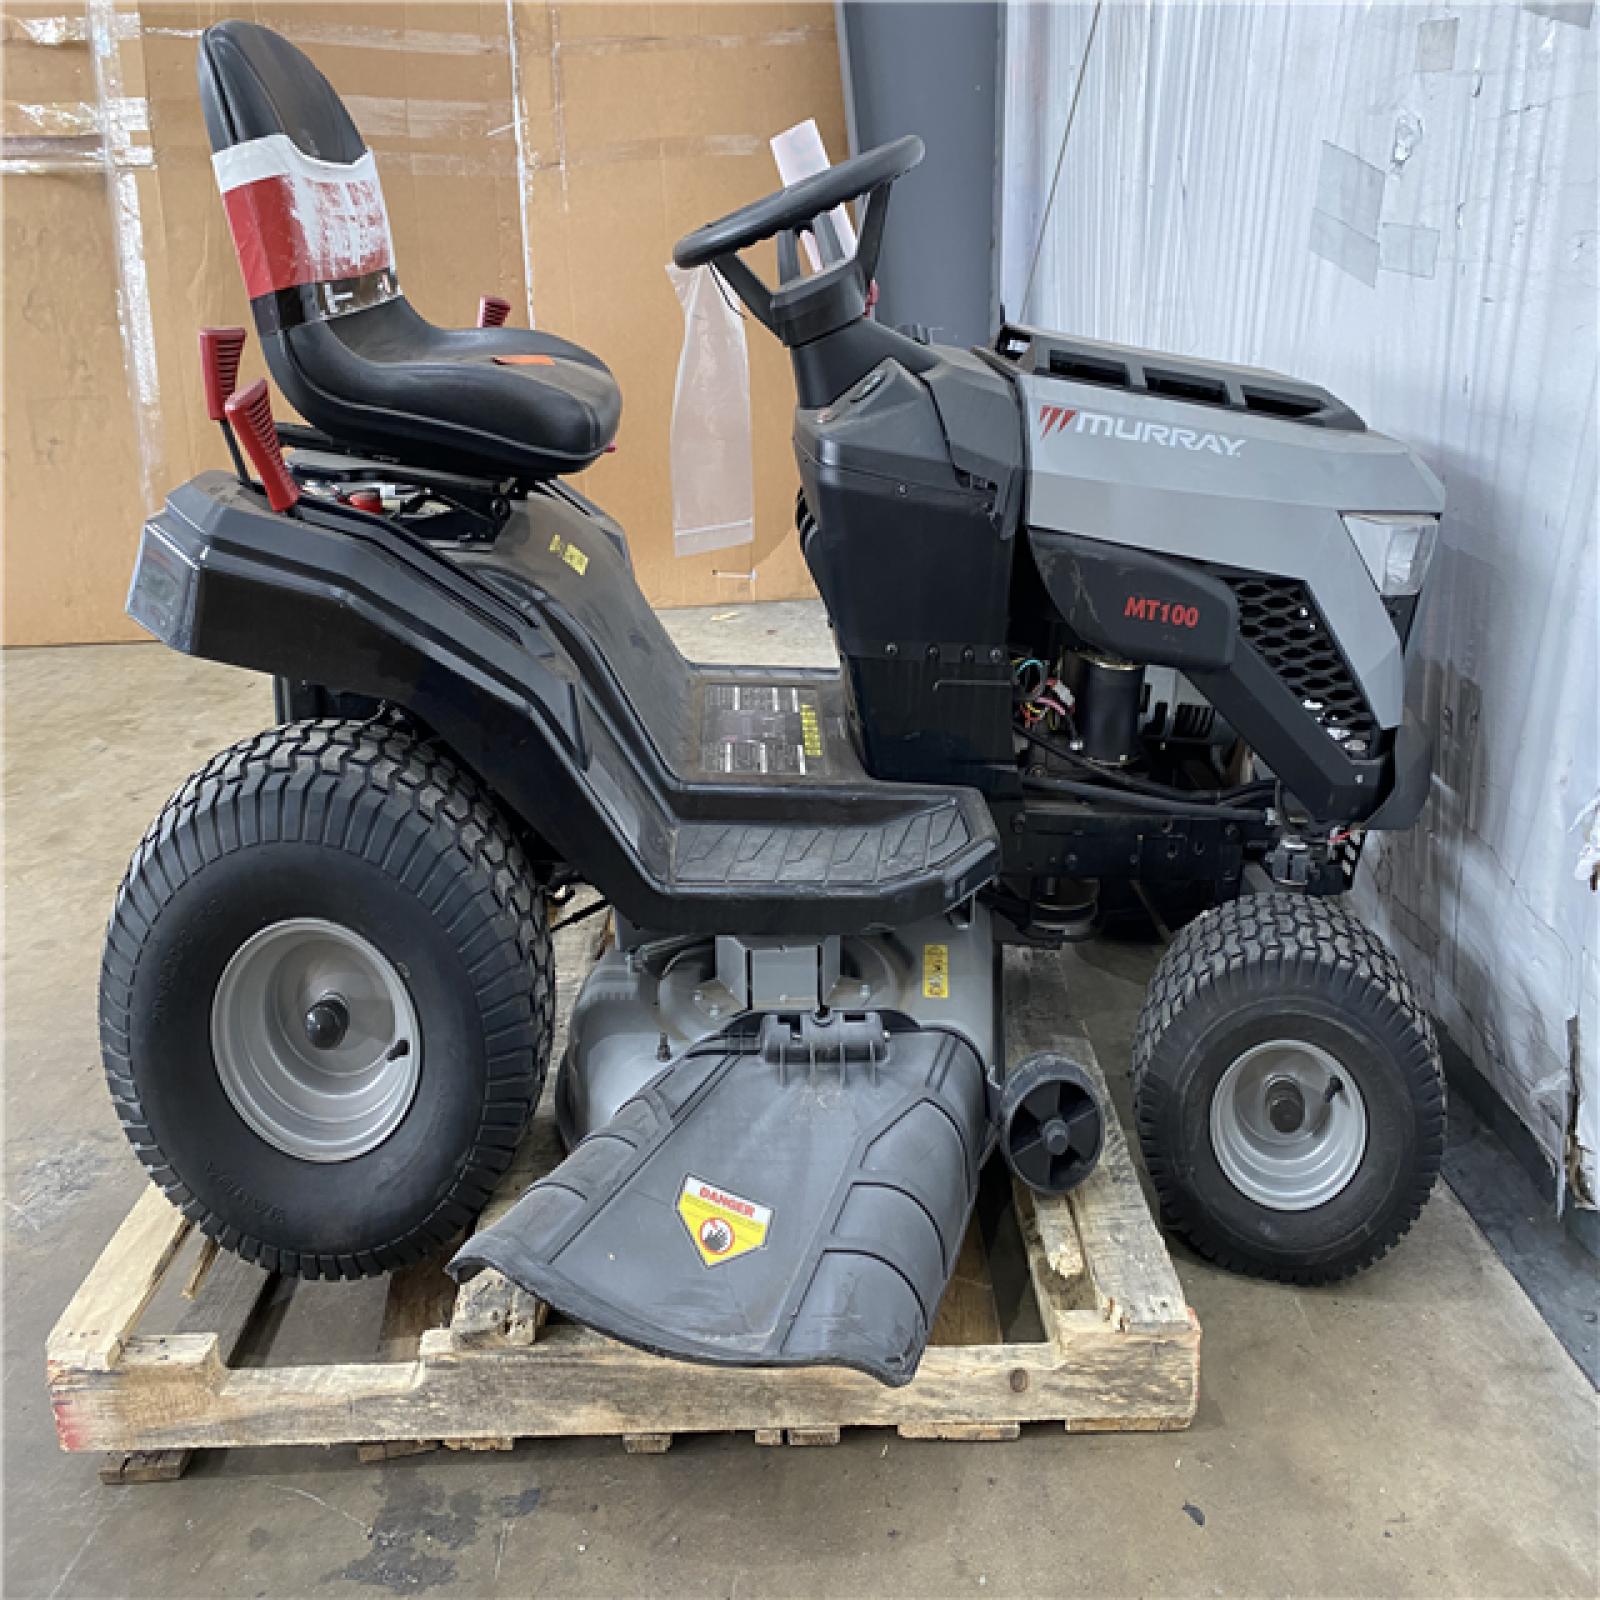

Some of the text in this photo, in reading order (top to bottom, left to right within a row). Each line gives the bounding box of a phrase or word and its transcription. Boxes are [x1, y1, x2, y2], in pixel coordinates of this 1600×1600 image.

[1075, 412, 1246, 457] MURRAY
[1124, 596, 1199, 628] MT100
[700, 1187, 755, 1217] DANGER
